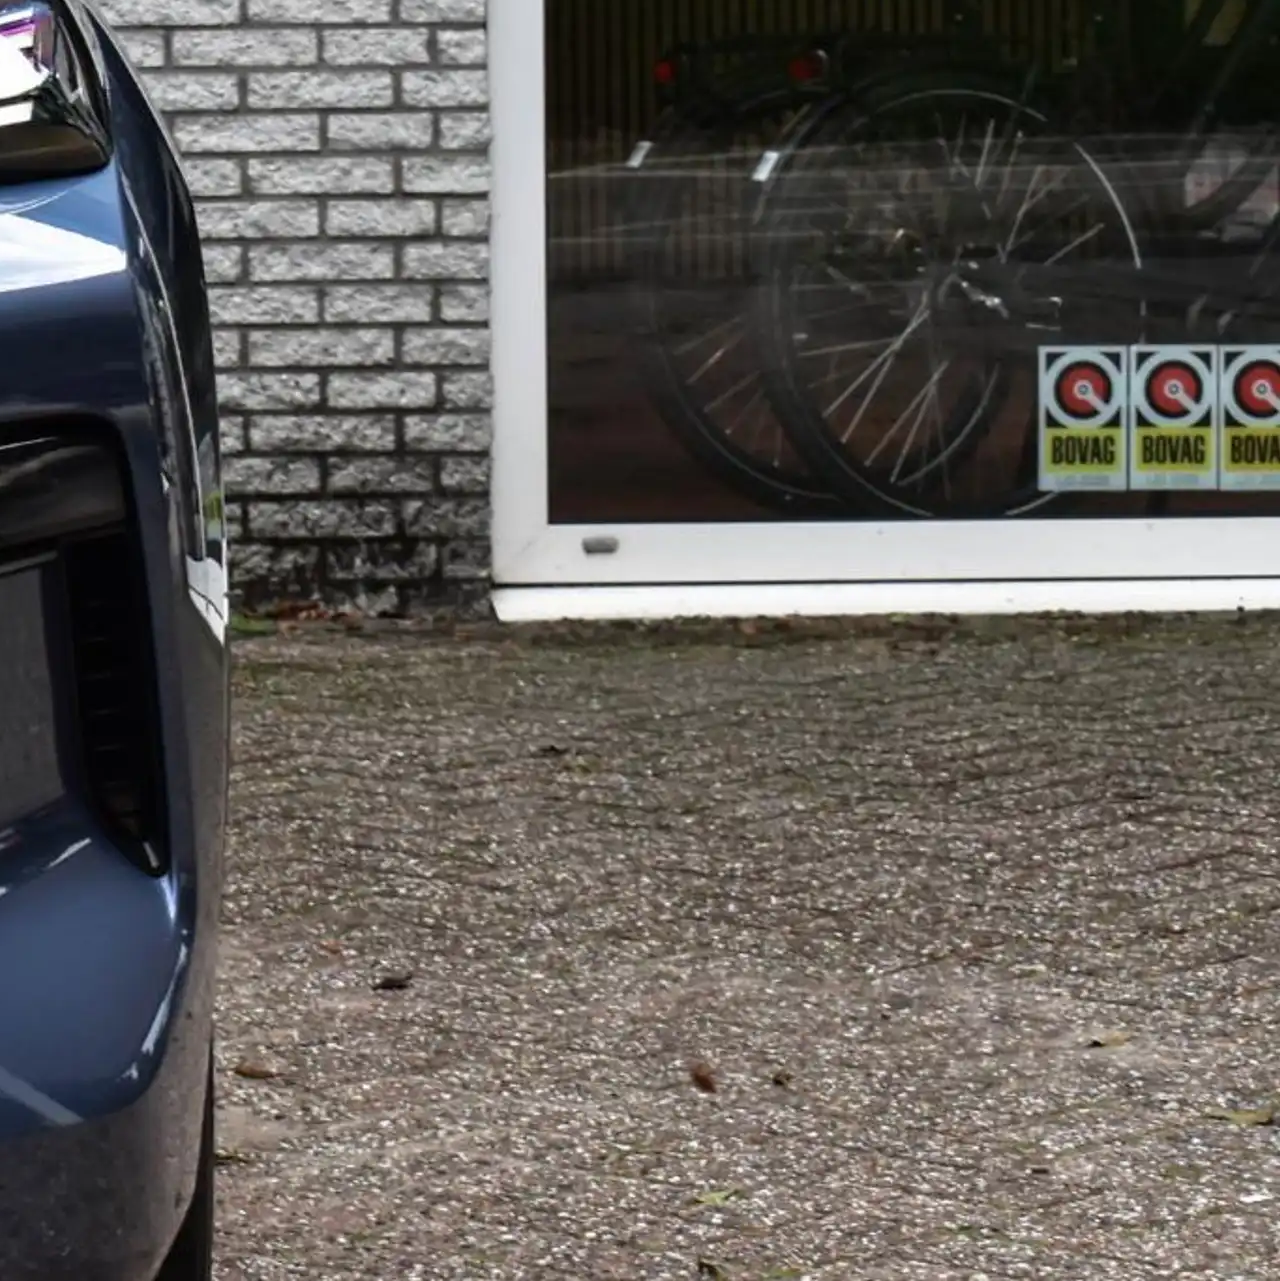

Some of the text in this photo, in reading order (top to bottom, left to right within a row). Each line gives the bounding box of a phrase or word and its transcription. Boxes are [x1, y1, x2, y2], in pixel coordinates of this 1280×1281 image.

[1051, 435, 1116, 465] BOVAG
[1142, 435, 1206, 465] BOVAG
[1230, 435, 1280, 465] BOVA
